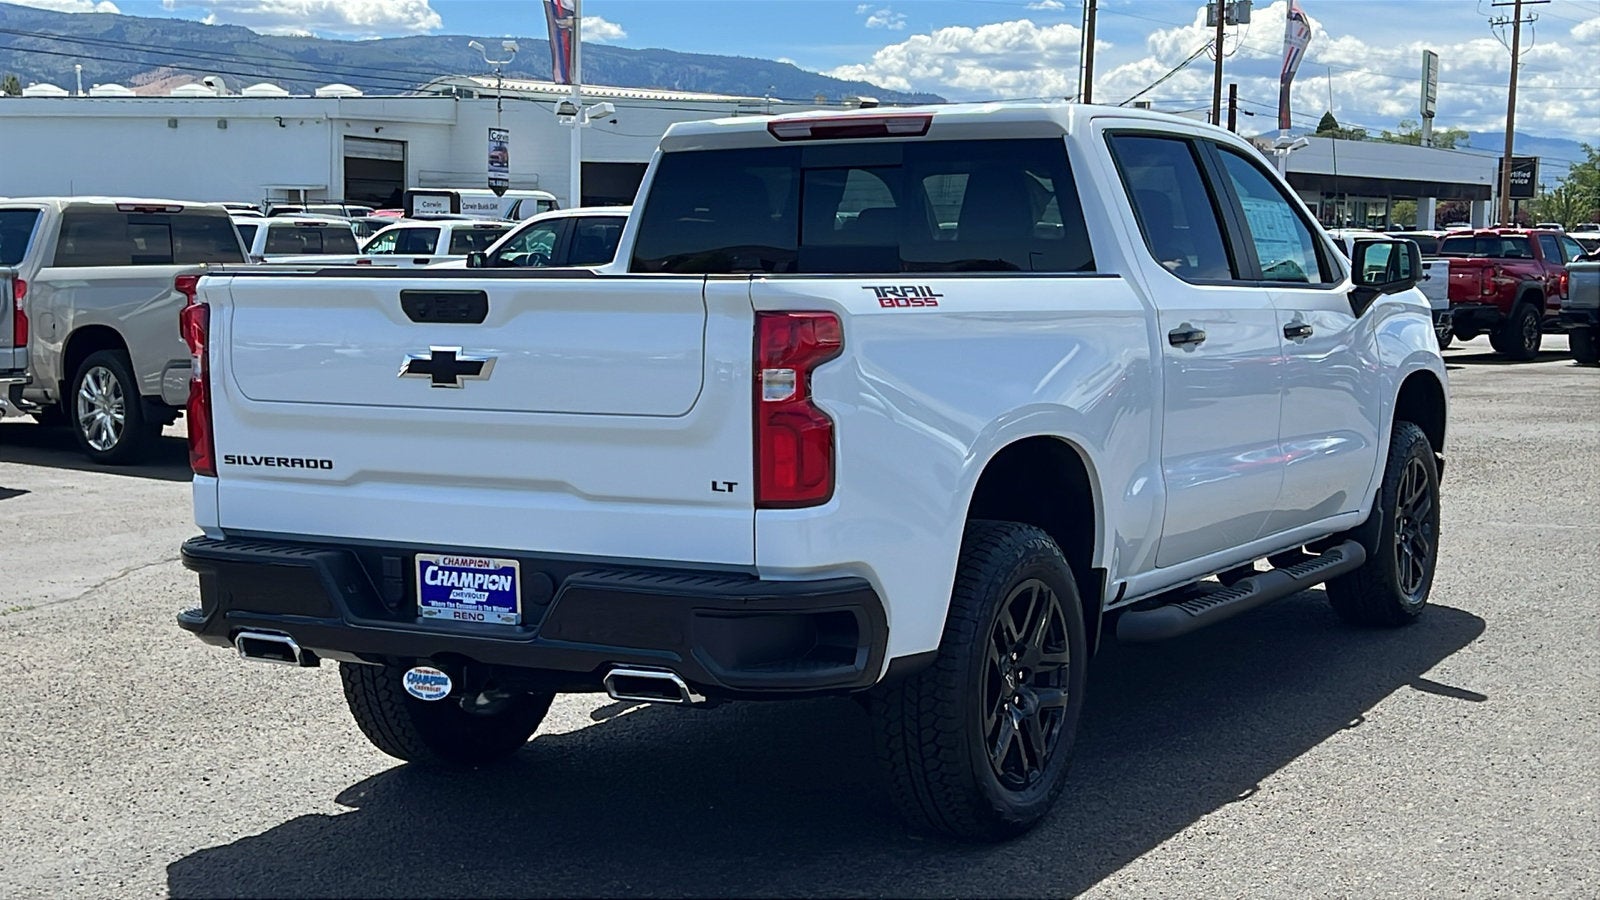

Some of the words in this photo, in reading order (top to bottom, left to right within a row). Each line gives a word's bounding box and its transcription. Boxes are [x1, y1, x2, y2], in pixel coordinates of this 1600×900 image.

[862, 286, 944, 297] TRAIL
[879, 298, 939, 308] BOSS
[224, 455, 333, 469] SILVERADO
[712, 481, 738, 492] LT
[443, 557, 491, 568] CHAMPION
[425, 565, 512, 591] CHAMPION
[452, 591, 486, 600] CHEVROLET
[454, 611, 485, 621] RENO
